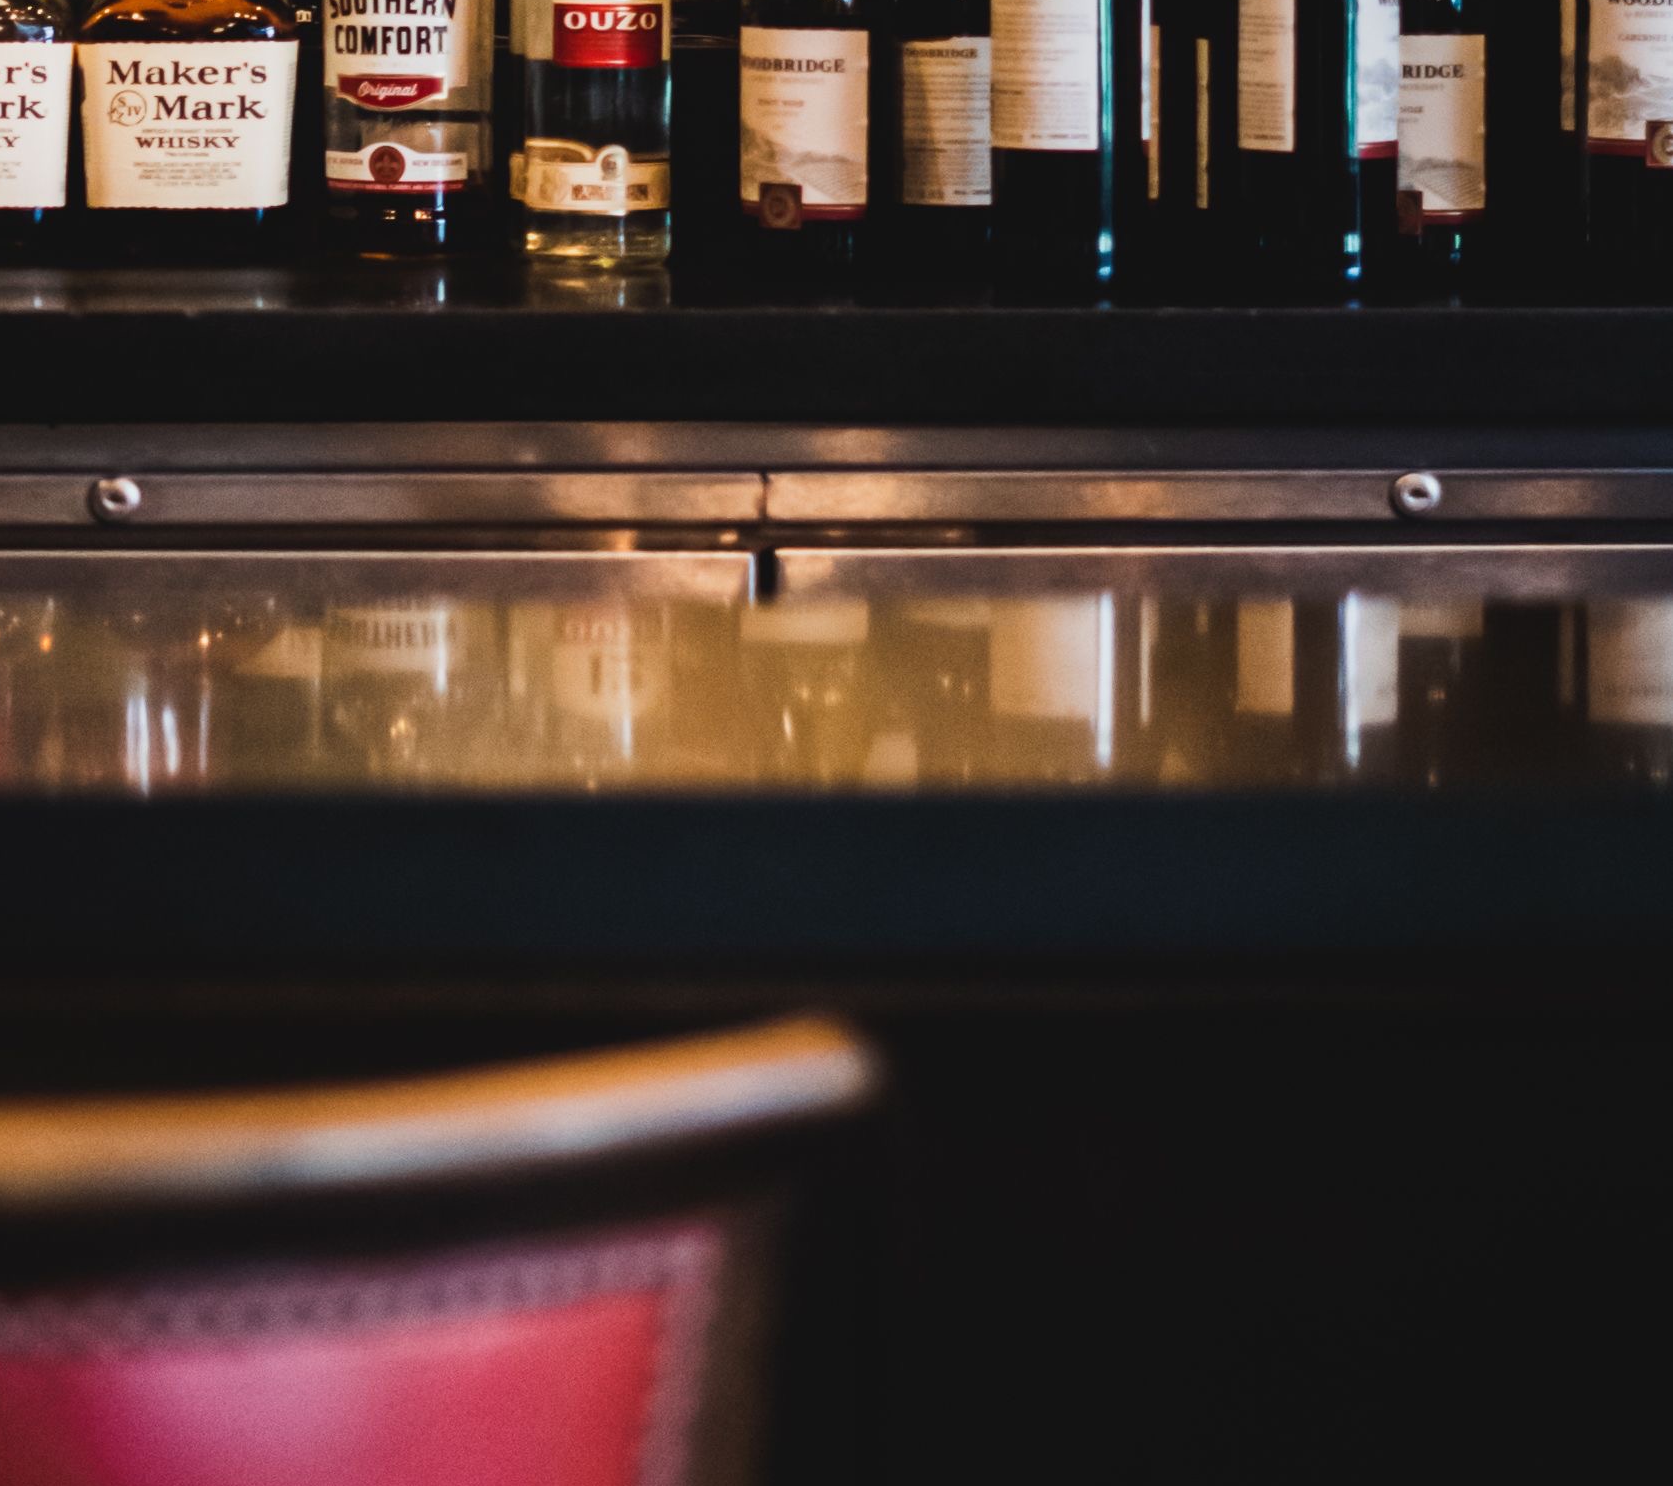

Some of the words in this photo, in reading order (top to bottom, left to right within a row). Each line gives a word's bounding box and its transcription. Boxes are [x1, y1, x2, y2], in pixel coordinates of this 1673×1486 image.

[562, 10, 657, 32] OUZO
[334, 24, 448, 56] COMFORT
[105, 59, 268, 86] Maker's
[1401, 63, 1465, 79] RIDGE
[357, 80, 419, 101] Original
[152, 94, 266, 121] Mark
[134, 136, 240, 149] WHISKY
